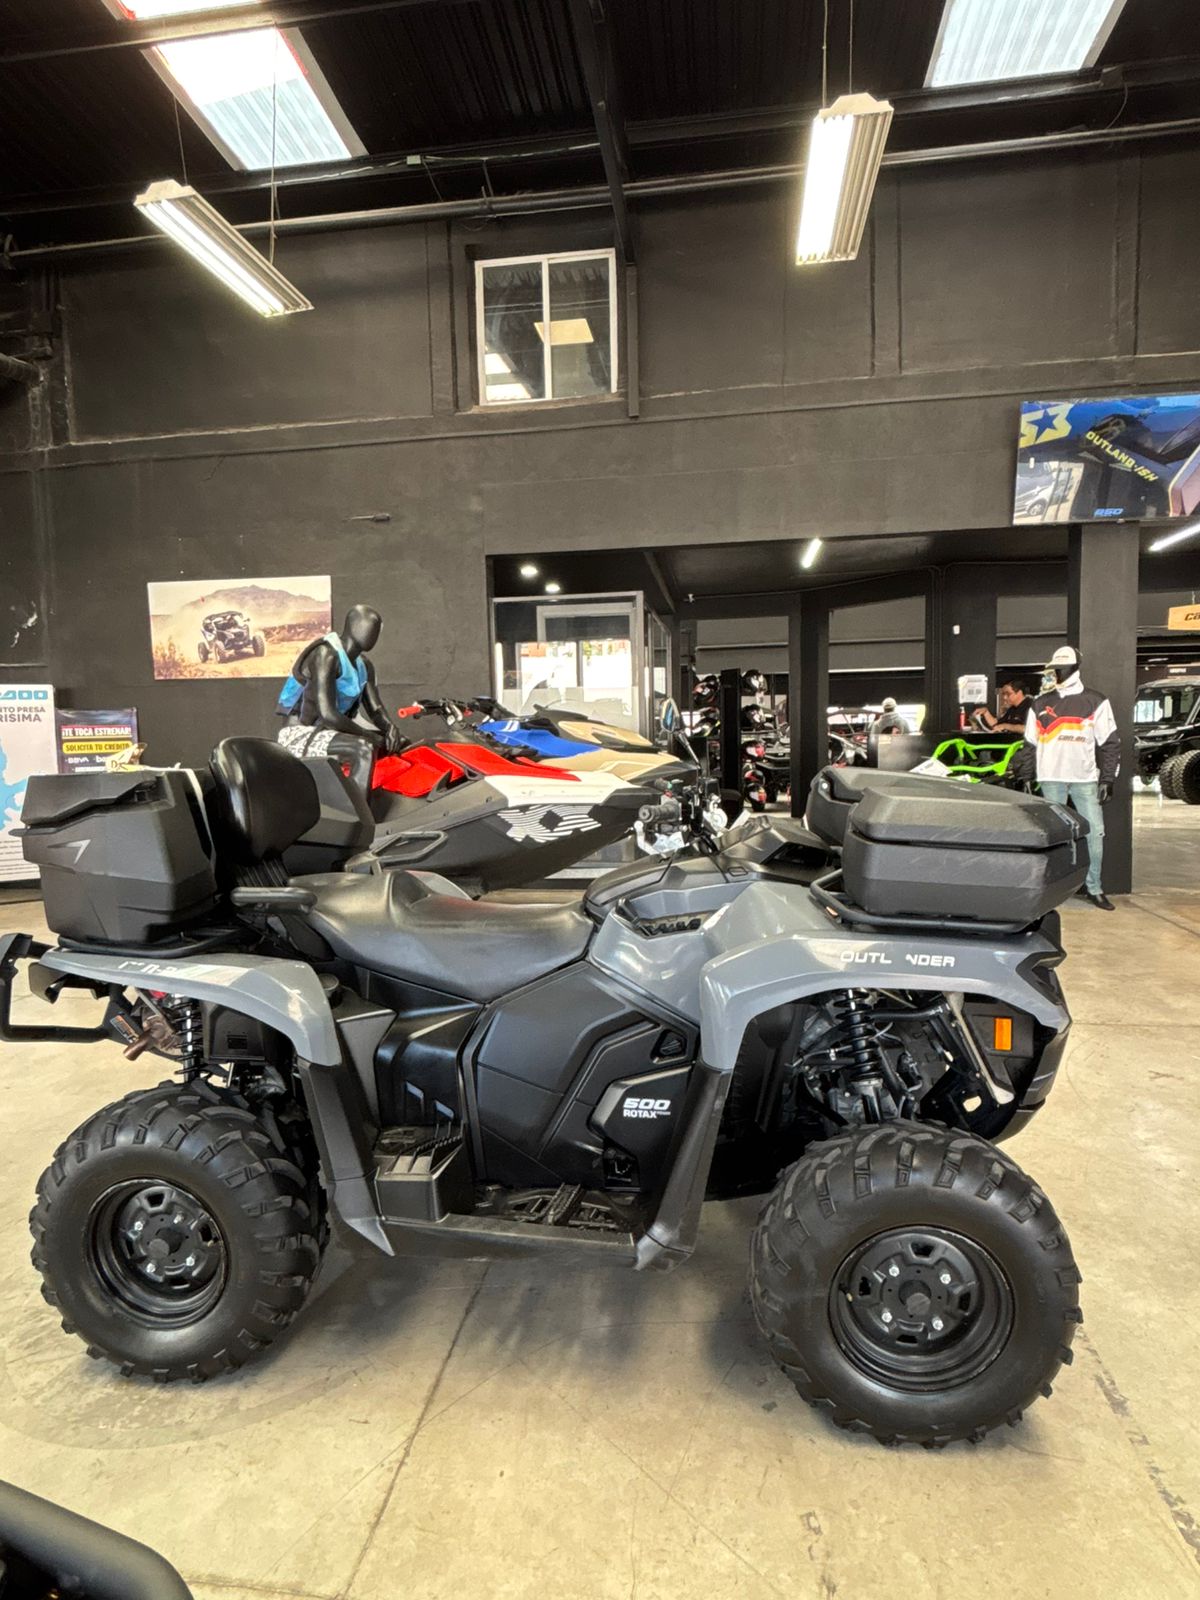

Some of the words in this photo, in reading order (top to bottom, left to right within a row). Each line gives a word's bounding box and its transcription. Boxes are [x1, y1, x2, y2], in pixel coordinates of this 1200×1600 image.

[75, 728, 93, 736] TOCA
[66, 744, 94, 752] SOLICITA
[623, 1098, 671, 1110] 500
[623, 1109, 657, 1118] ROTAX
